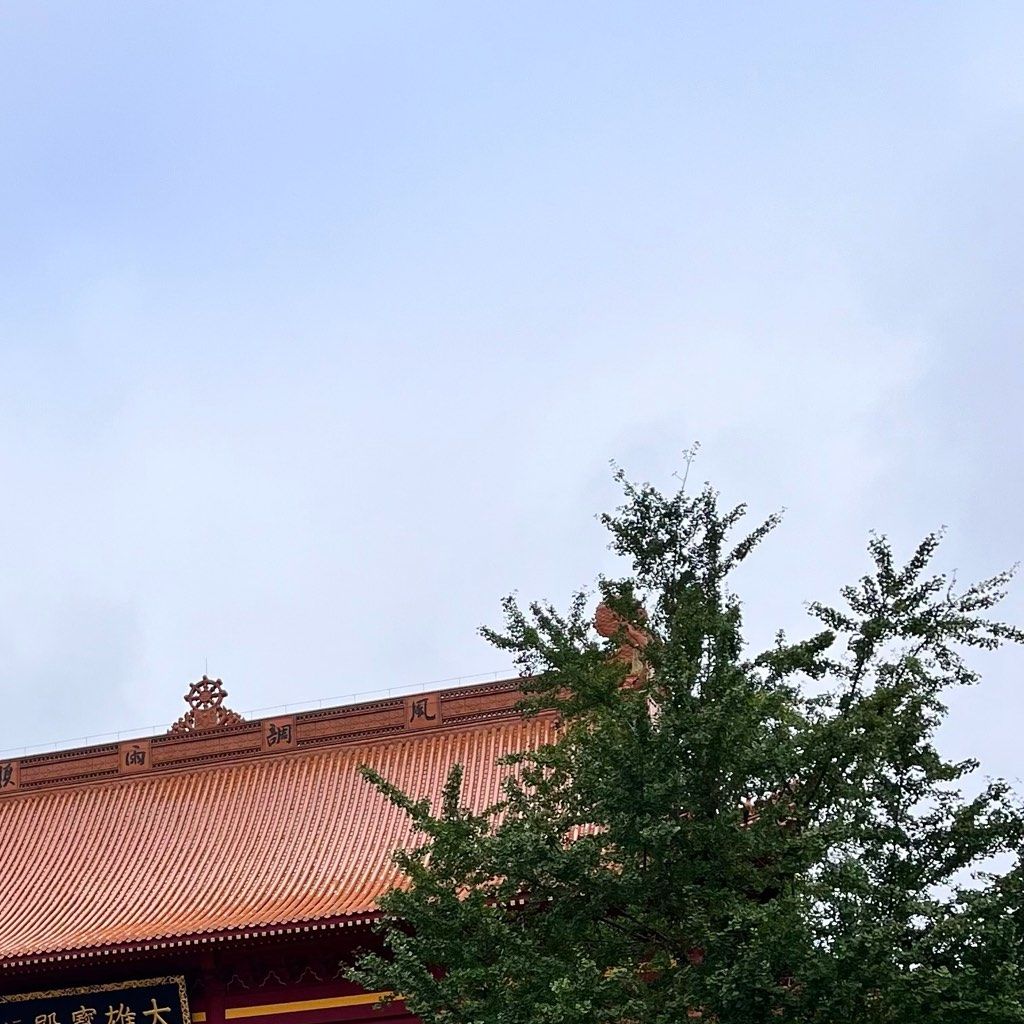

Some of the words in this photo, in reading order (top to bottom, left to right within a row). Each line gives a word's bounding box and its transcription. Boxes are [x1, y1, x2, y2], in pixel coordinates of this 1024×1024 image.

[410, 698, 436, 724] 風
[265, 723, 292, 746] 調
[124, 744, 147, 768] 雨
